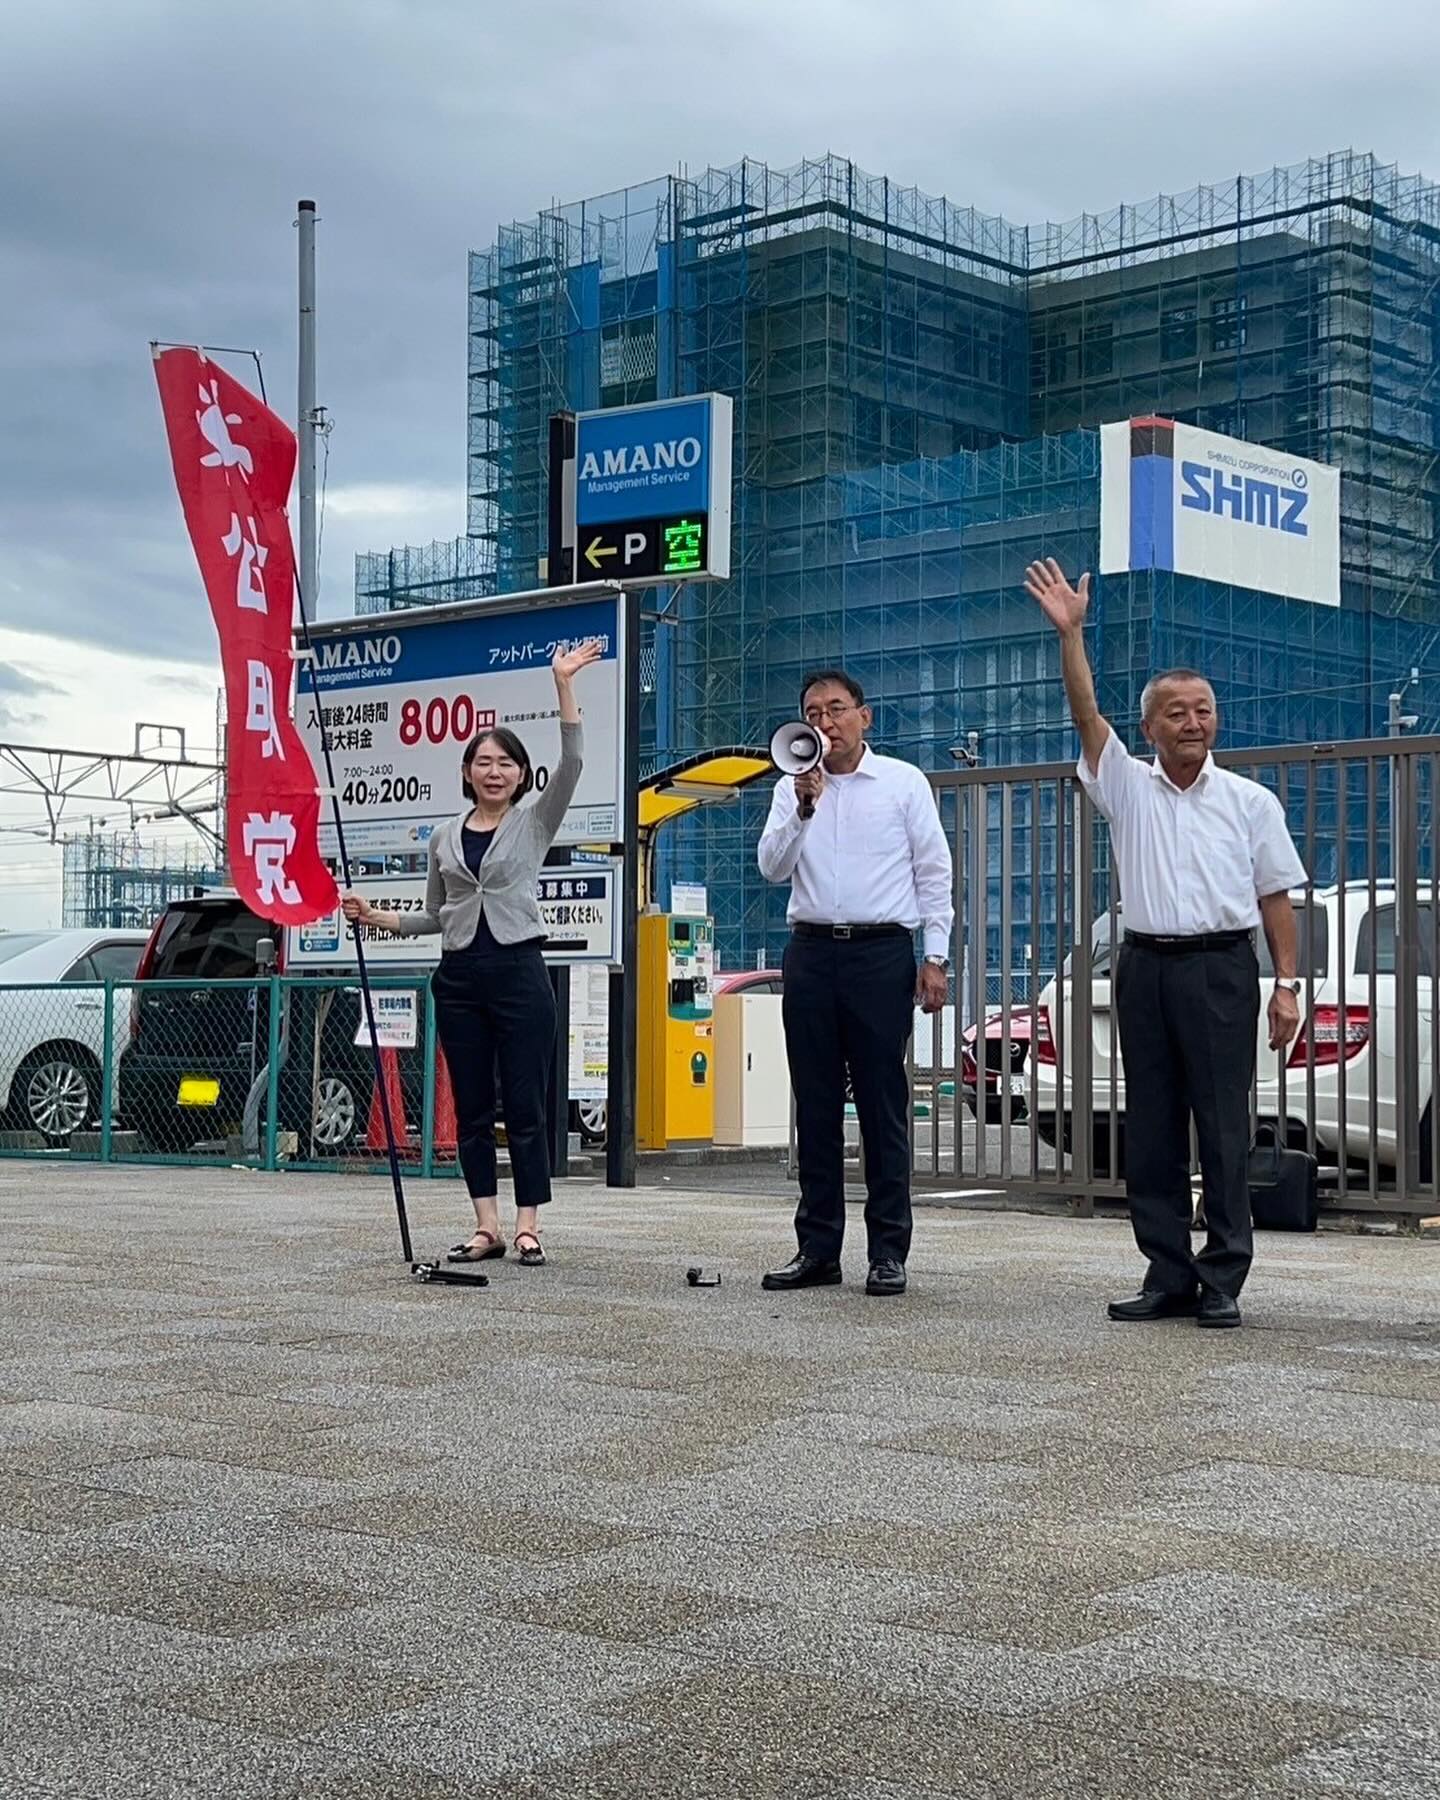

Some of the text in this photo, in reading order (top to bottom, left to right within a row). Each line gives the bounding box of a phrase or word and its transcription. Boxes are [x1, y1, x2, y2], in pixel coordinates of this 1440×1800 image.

[579, 437, 701, 480] AMANO
[1239, 459, 1291, 481] CORPORATION
[588, 470, 690, 494] Management Service
[625, 532, 647, 565] P
[664, 519, 701, 571] 空
[302, 635, 402, 672] AMANO
[361, 665, 394, 680] Service
[307, 701, 389, 729] 入庫後24時間
[342, 775, 432, 806] 40分200円
